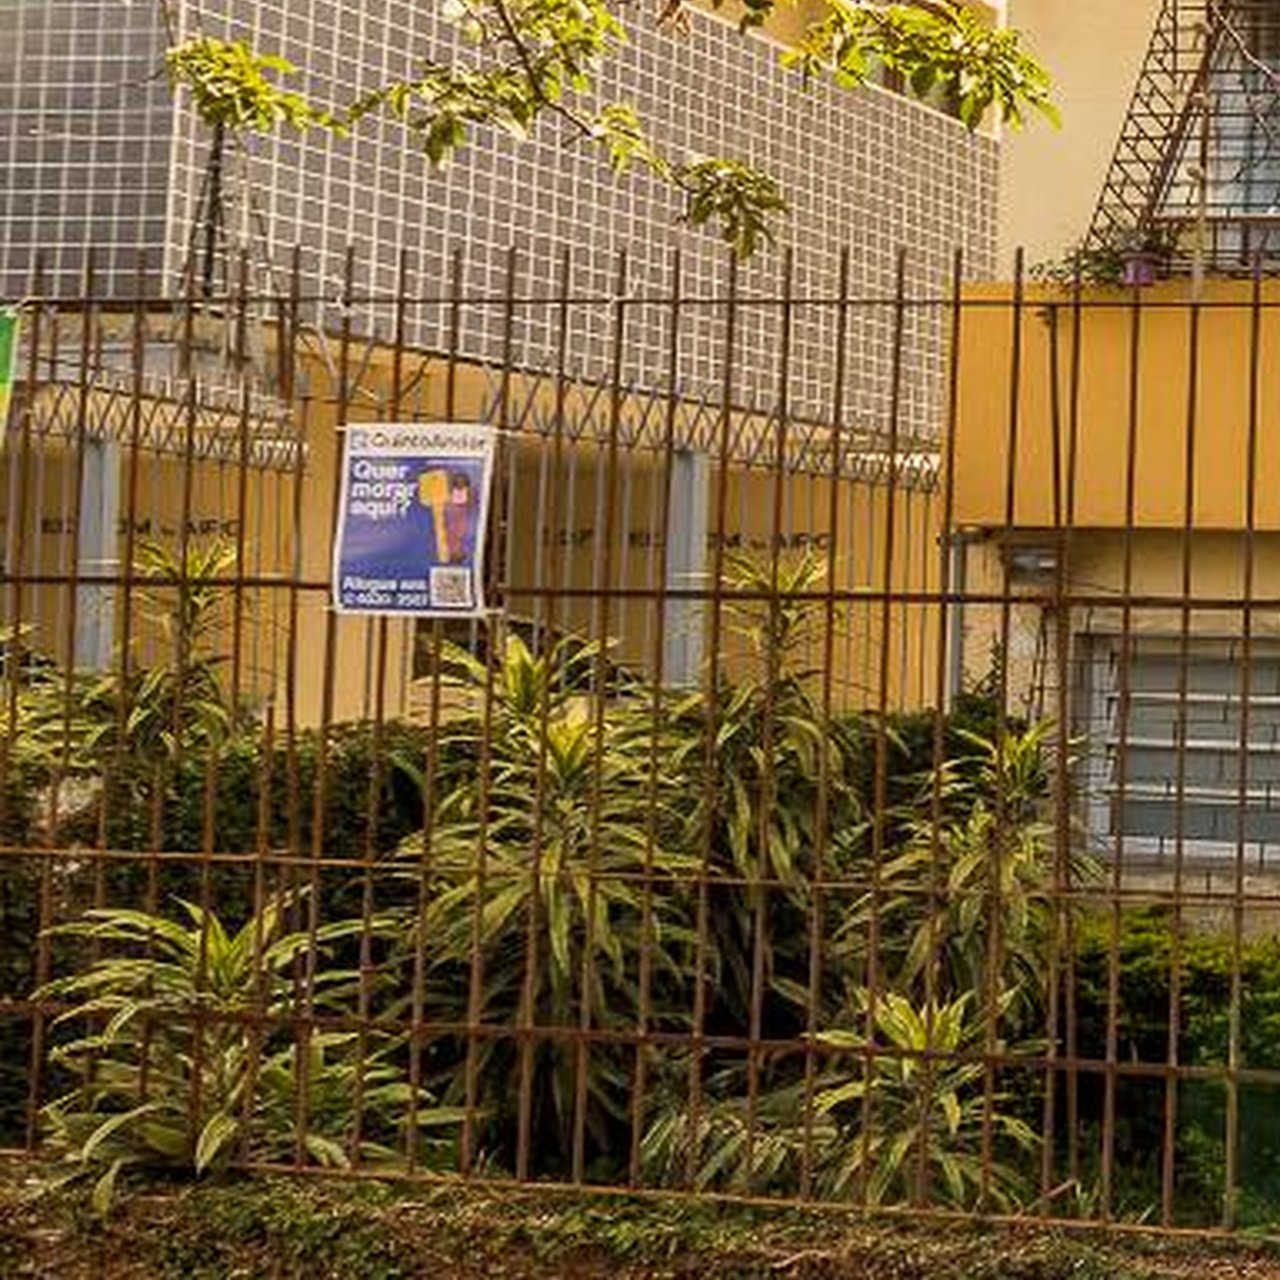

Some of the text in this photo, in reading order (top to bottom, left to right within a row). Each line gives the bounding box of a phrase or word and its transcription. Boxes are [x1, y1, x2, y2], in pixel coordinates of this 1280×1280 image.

[353, 460, 411, 480] Quer
[351, 480, 419, 499] morar
[349, 498, 412, 520] aqui?
